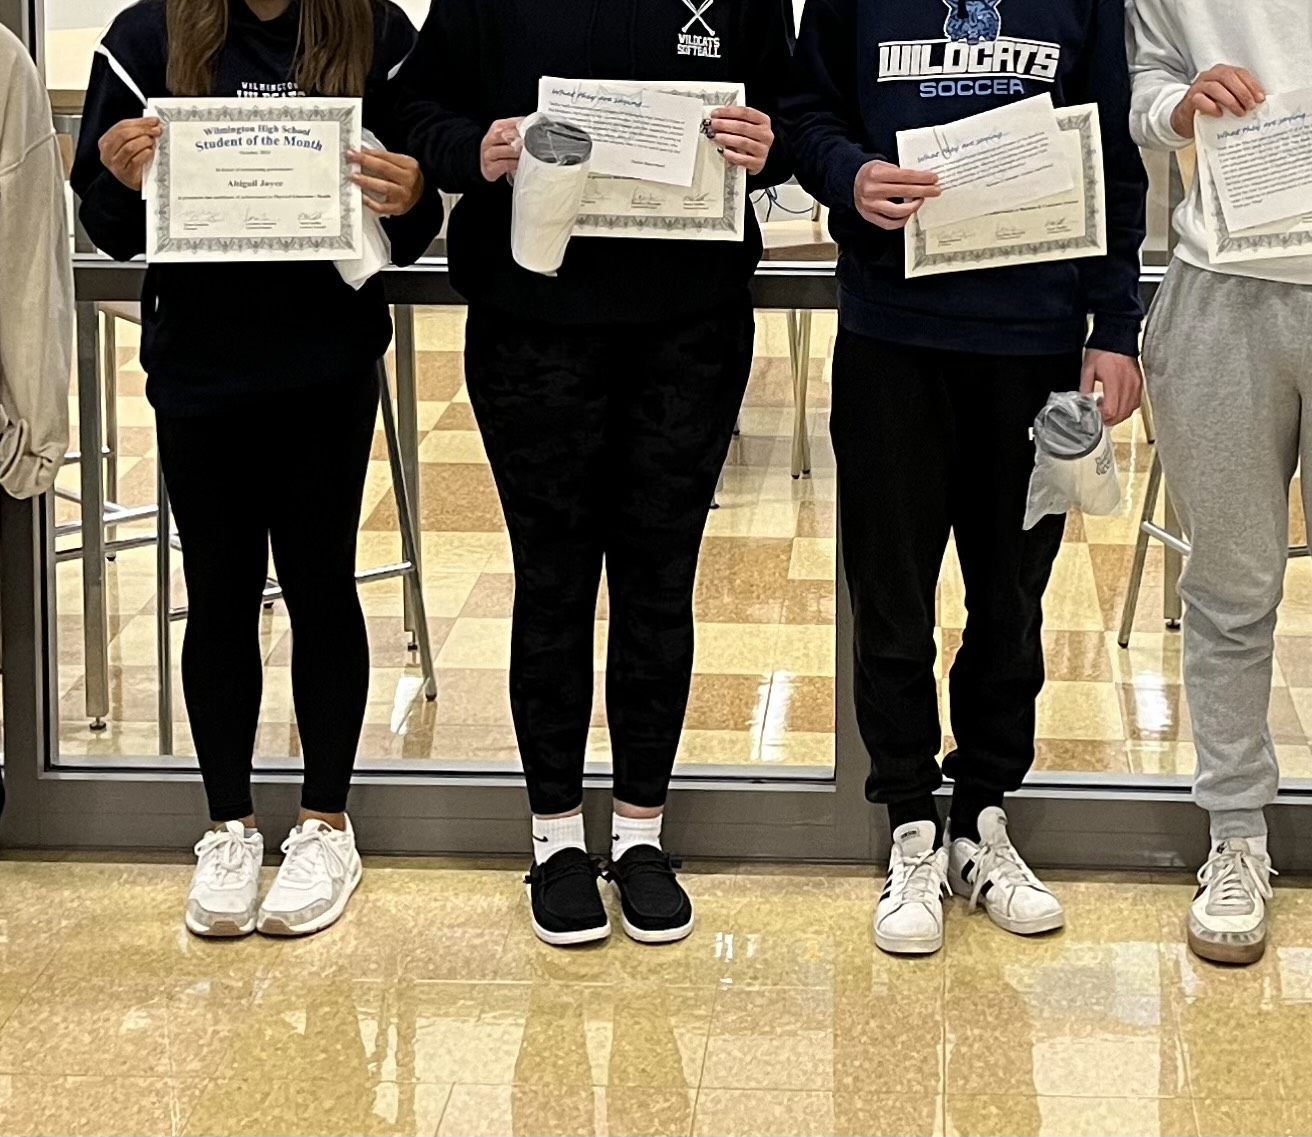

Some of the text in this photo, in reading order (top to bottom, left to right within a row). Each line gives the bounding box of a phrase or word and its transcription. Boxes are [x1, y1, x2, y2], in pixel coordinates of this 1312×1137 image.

[677, 32, 720, 48] WILDCATS
[878, 41, 1061, 79] WILDCATS
[919, 78, 1025, 98] SOCCER
[203, 124, 311, 136] Wilmington High School
[195, 135, 323, 152] Student of the Month
